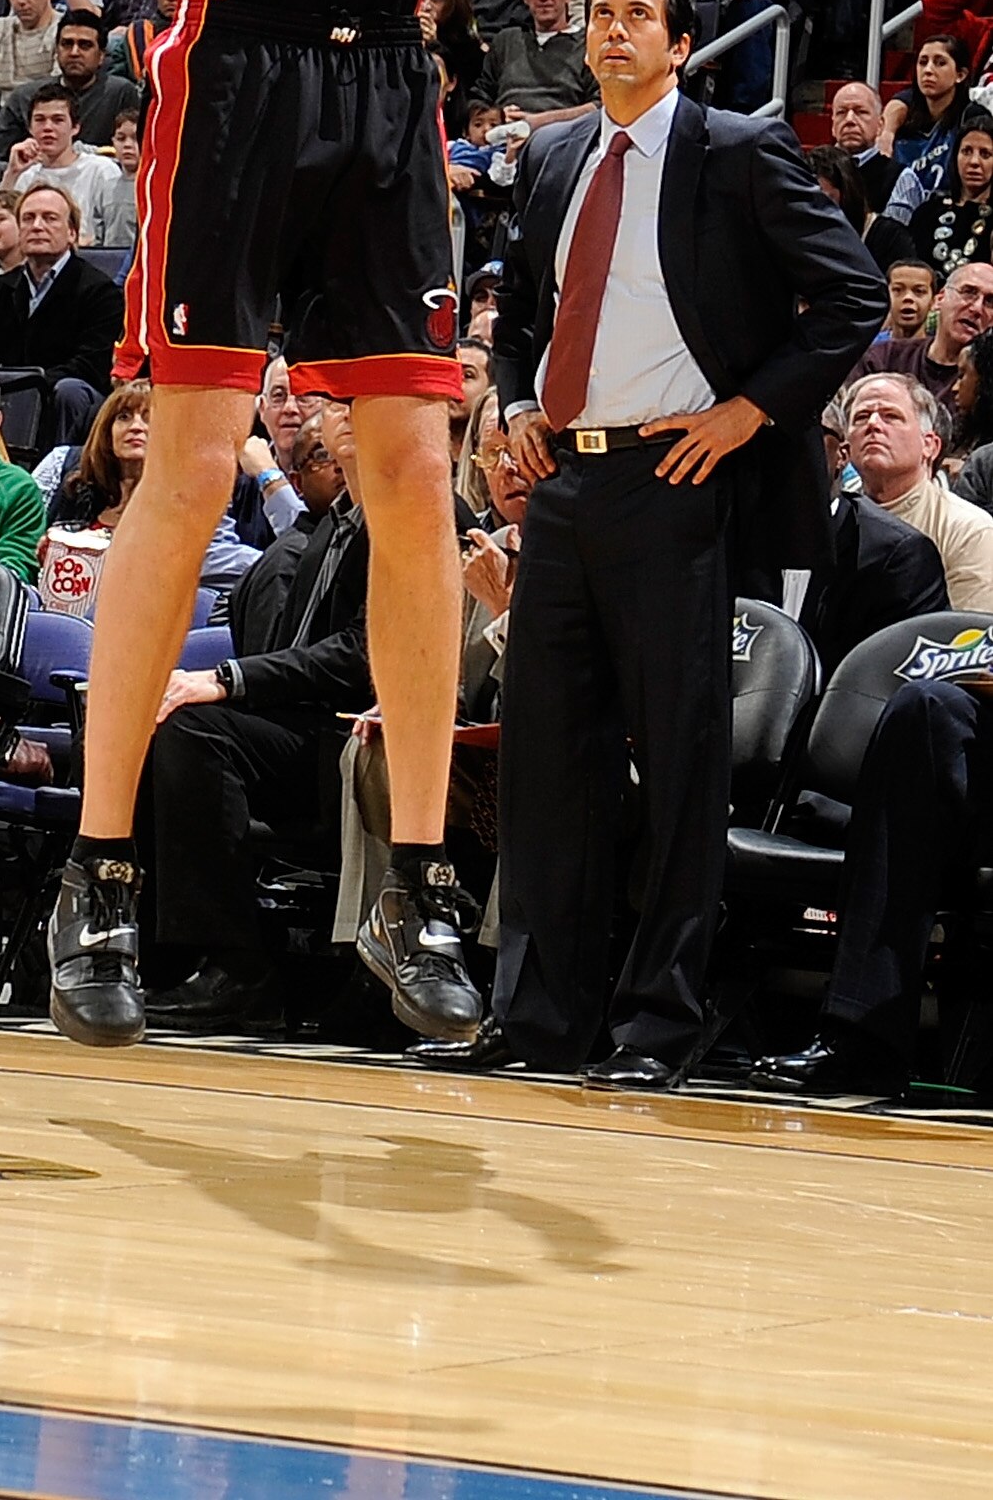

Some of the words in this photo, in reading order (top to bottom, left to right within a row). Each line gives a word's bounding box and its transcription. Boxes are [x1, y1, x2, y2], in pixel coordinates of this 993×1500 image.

[54, 557, 84, 578] POP
[52, 577, 92, 597] CORN
[908, 638, 993, 680] Sprite
